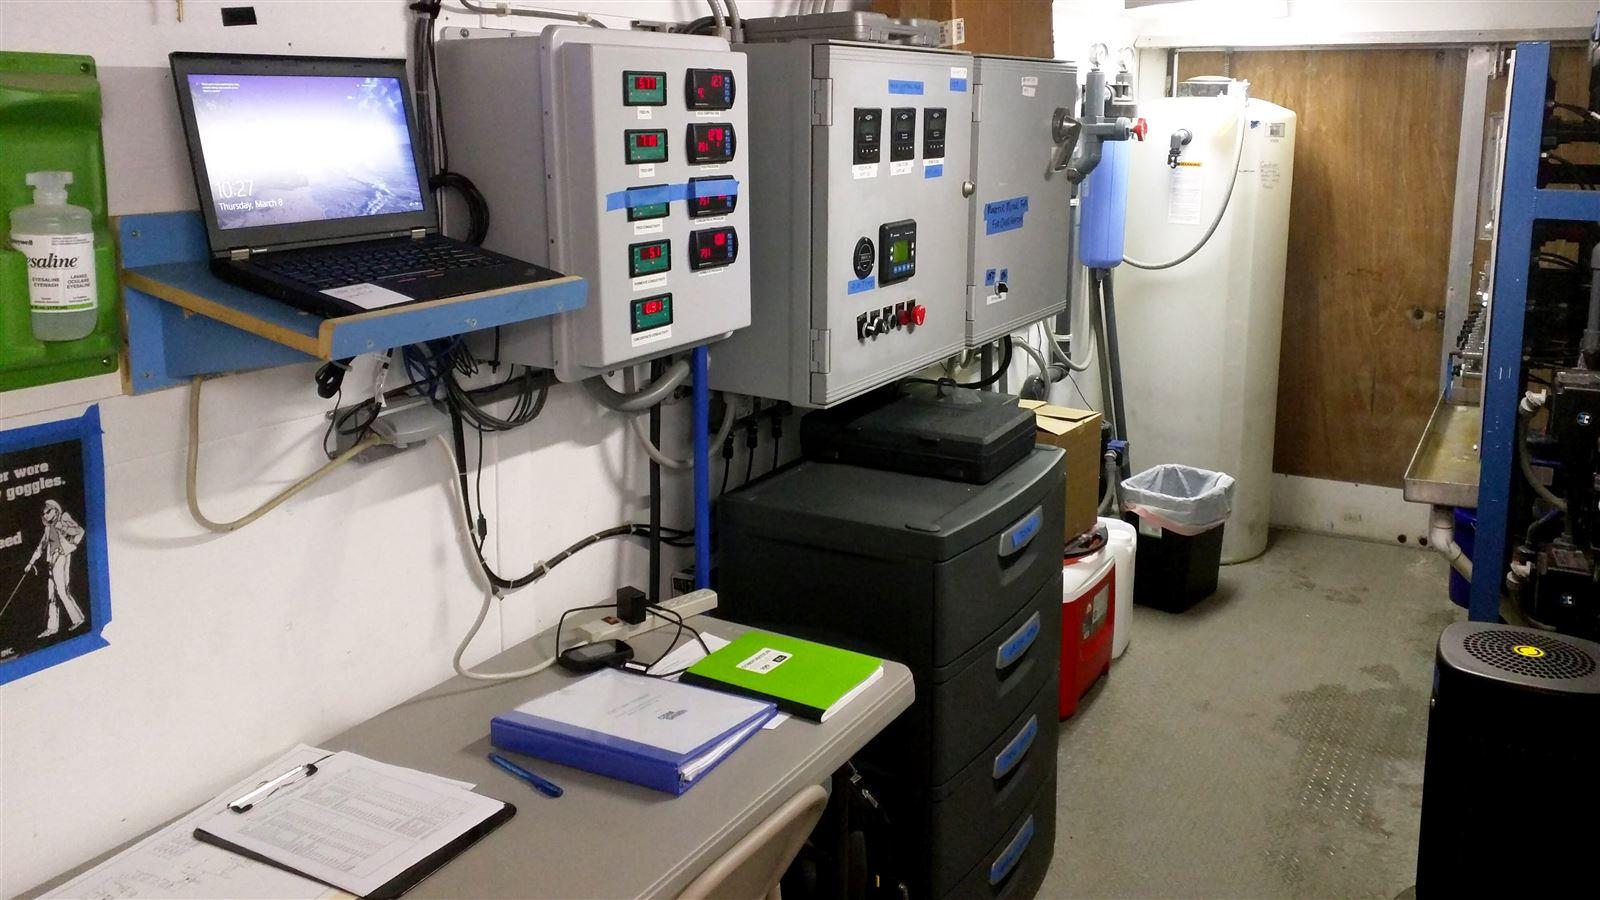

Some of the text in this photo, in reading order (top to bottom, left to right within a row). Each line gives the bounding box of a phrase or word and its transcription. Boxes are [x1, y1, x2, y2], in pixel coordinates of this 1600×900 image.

[215, 179, 254, 199] 10:27
[218, 197, 284, 211] Thursday, March 8
[14, 462, 49, 479] wore
[6, 476, 66, 501] goggles.
